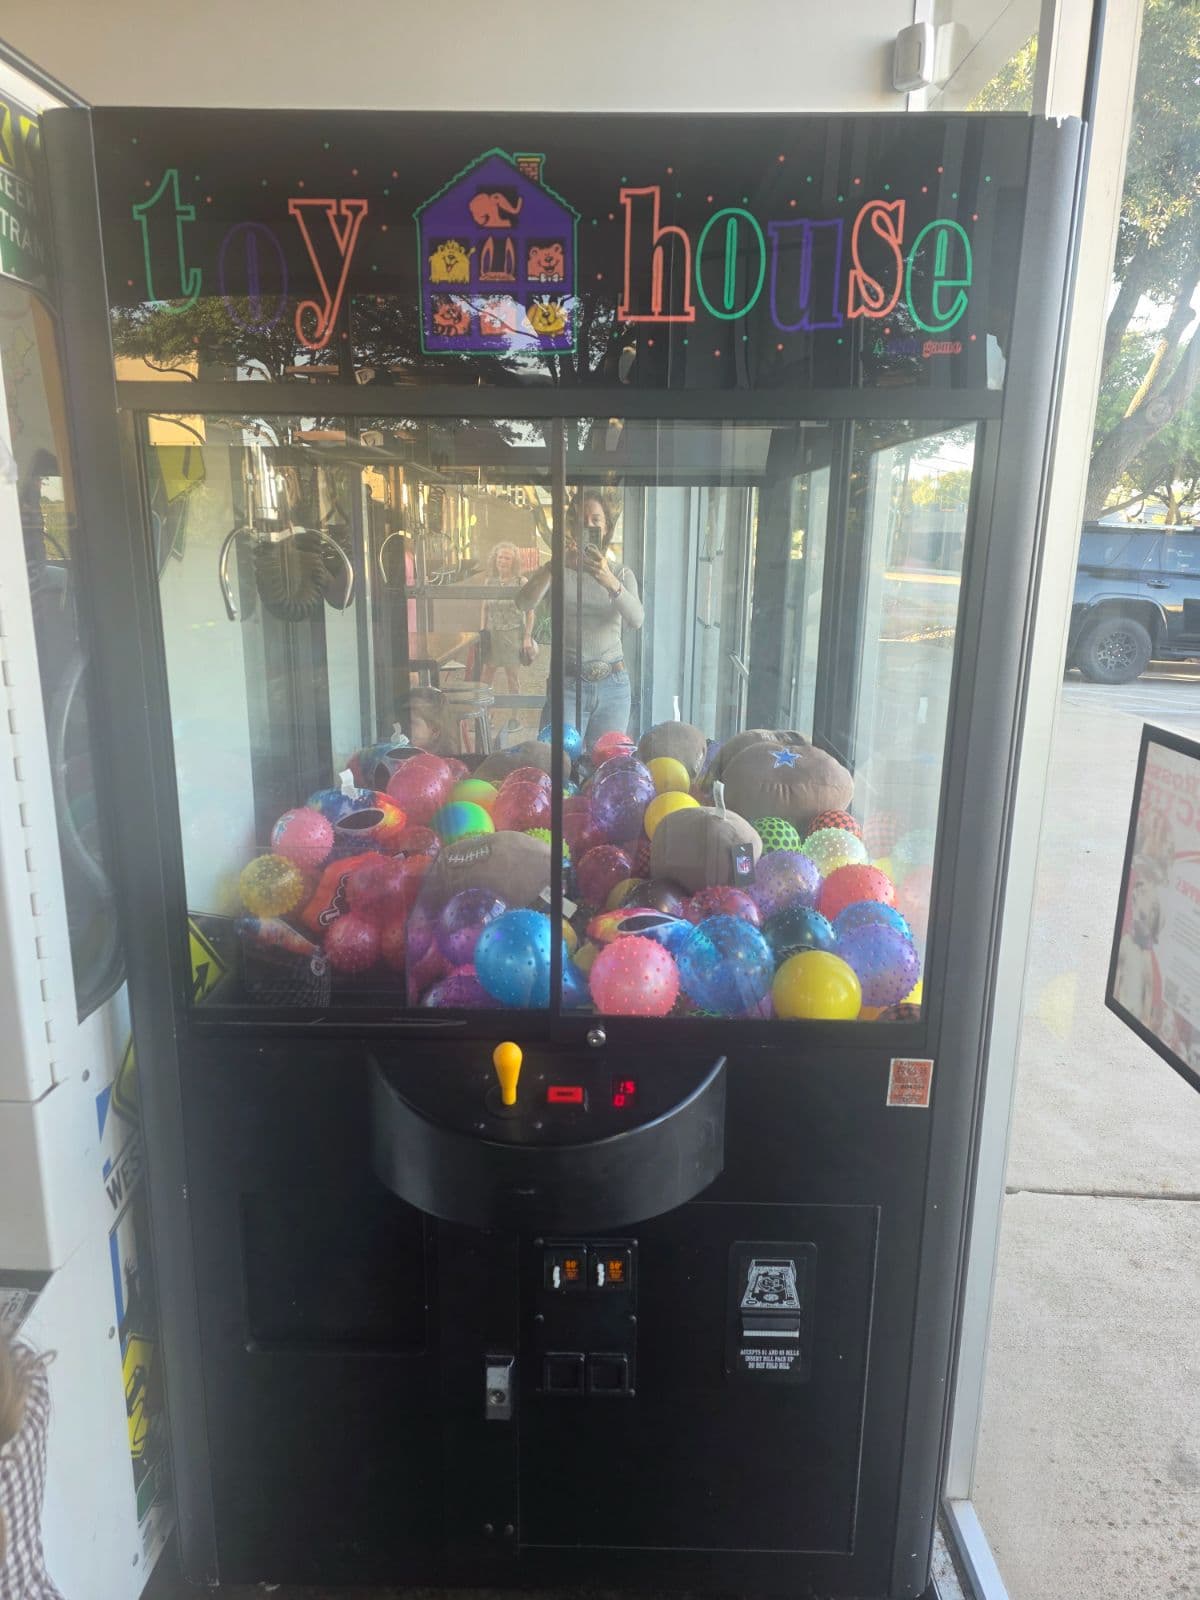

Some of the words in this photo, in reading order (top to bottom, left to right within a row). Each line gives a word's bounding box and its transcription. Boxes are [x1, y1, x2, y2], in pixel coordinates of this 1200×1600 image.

[132, 168, 368, 350] toy
[617, 185, 973, 333] house
[785, 1349, 800, 1357] BILLS
[778, 1362, 790, 1370] BILL
